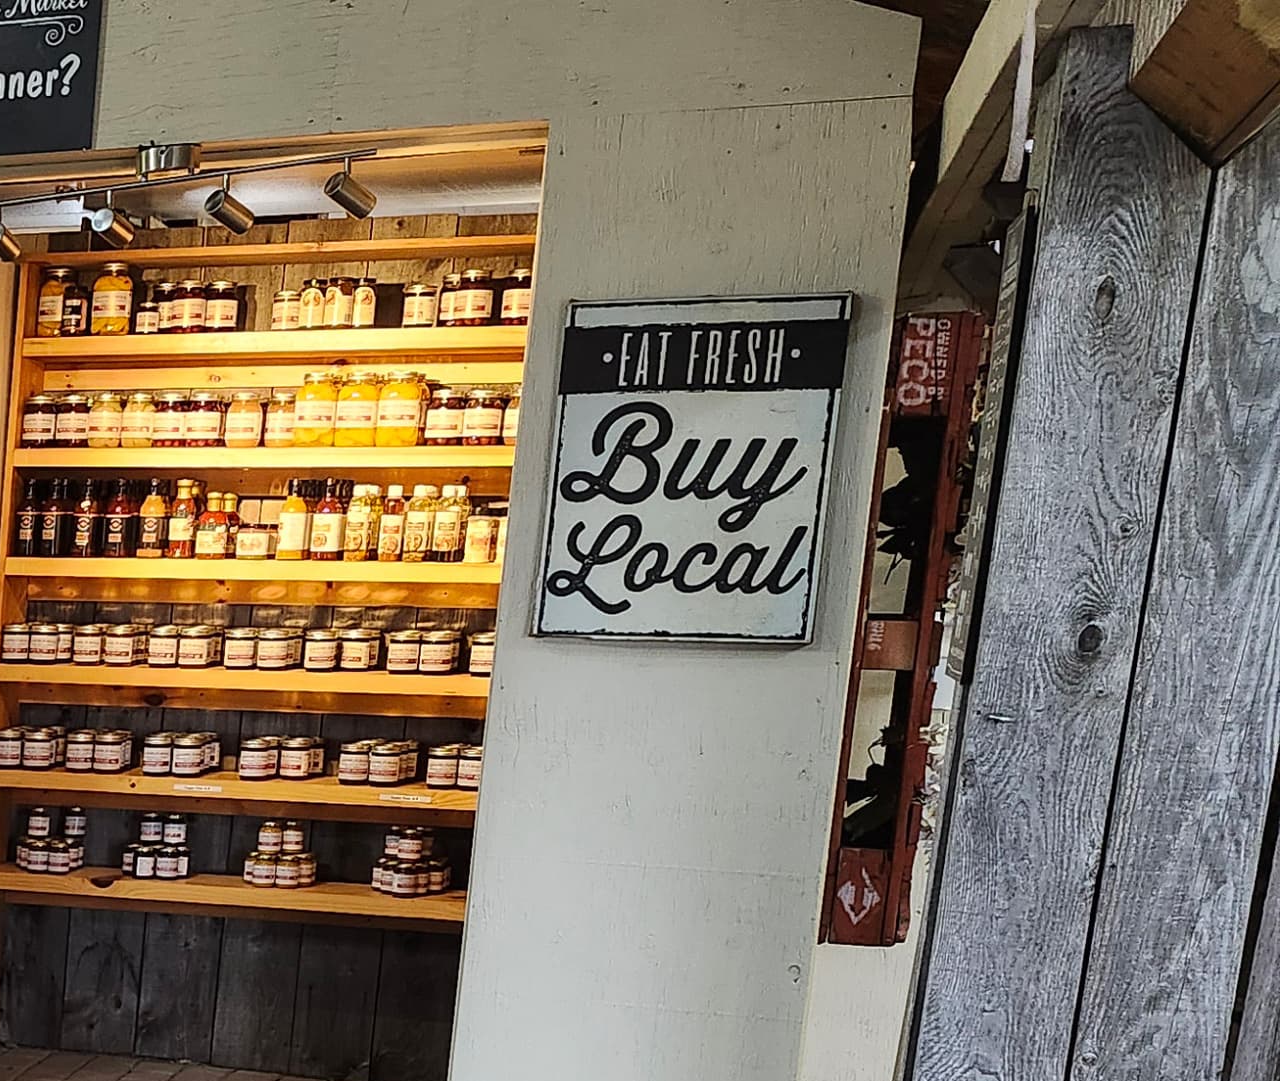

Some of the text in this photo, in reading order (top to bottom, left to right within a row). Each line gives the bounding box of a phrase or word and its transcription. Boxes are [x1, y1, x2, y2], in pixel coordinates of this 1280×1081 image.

[618, 328, 785, 387] EAT FRESH
[898, 318, 936, 406] PECO
[559, 401, 809, 533] Buy
[546, 513, 809, 615] Local
